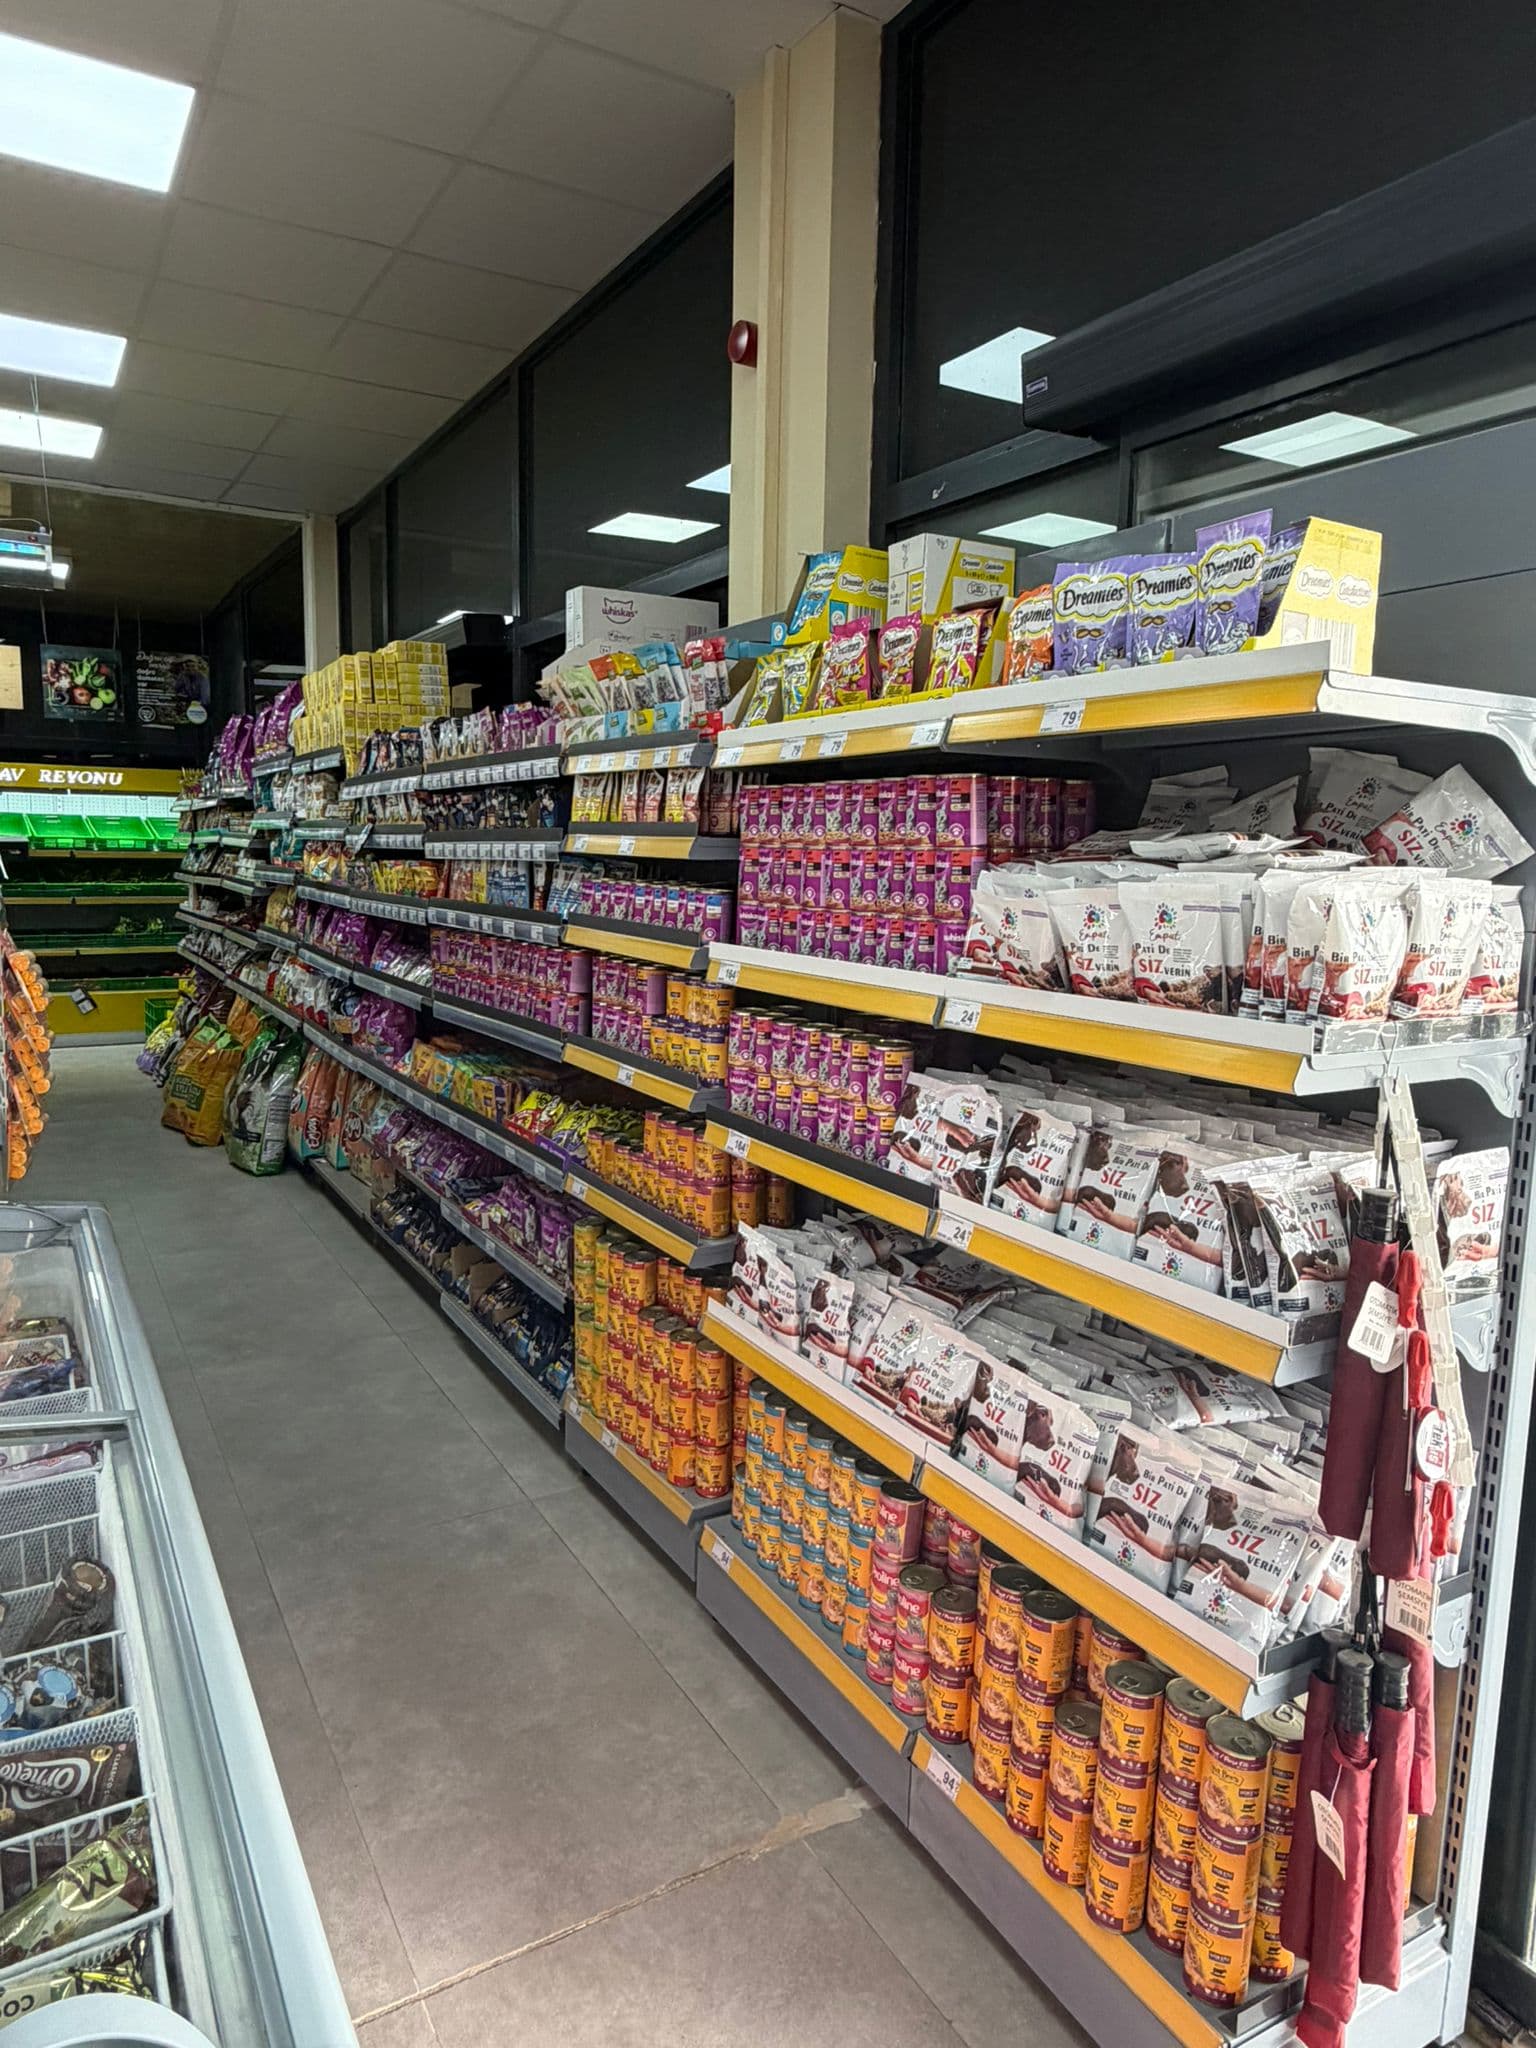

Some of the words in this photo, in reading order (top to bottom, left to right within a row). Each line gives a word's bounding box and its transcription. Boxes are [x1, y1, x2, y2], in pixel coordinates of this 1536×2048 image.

[1136, 573, 1194, 599] Dreamies
[1063, 585, 1126, 611] Dreamies
[602, 604, 635, 618] whiskas
[1061, 711, 1077, 726] 79
[925, 729, 938, 741] 79
[831, 741, 842, 752] 79
[38, 769, 124, 785] REYONU
[1164, 965, 1190, 977] VERİN
[960, 1010, 973, 1023] 24
[953, 1227, 966, 1241] 24
[1328, 1233, 1348, 1250] VERİ
[1147, 1510, 1173, 1531] VERİN
[1227, 1530, 1266, 1556] SİZ
[1247, 1555, 1282, 1577] VERİN
[943, 1773, 955, 1788] 94
[0, 1994, 35, 2018] CO
